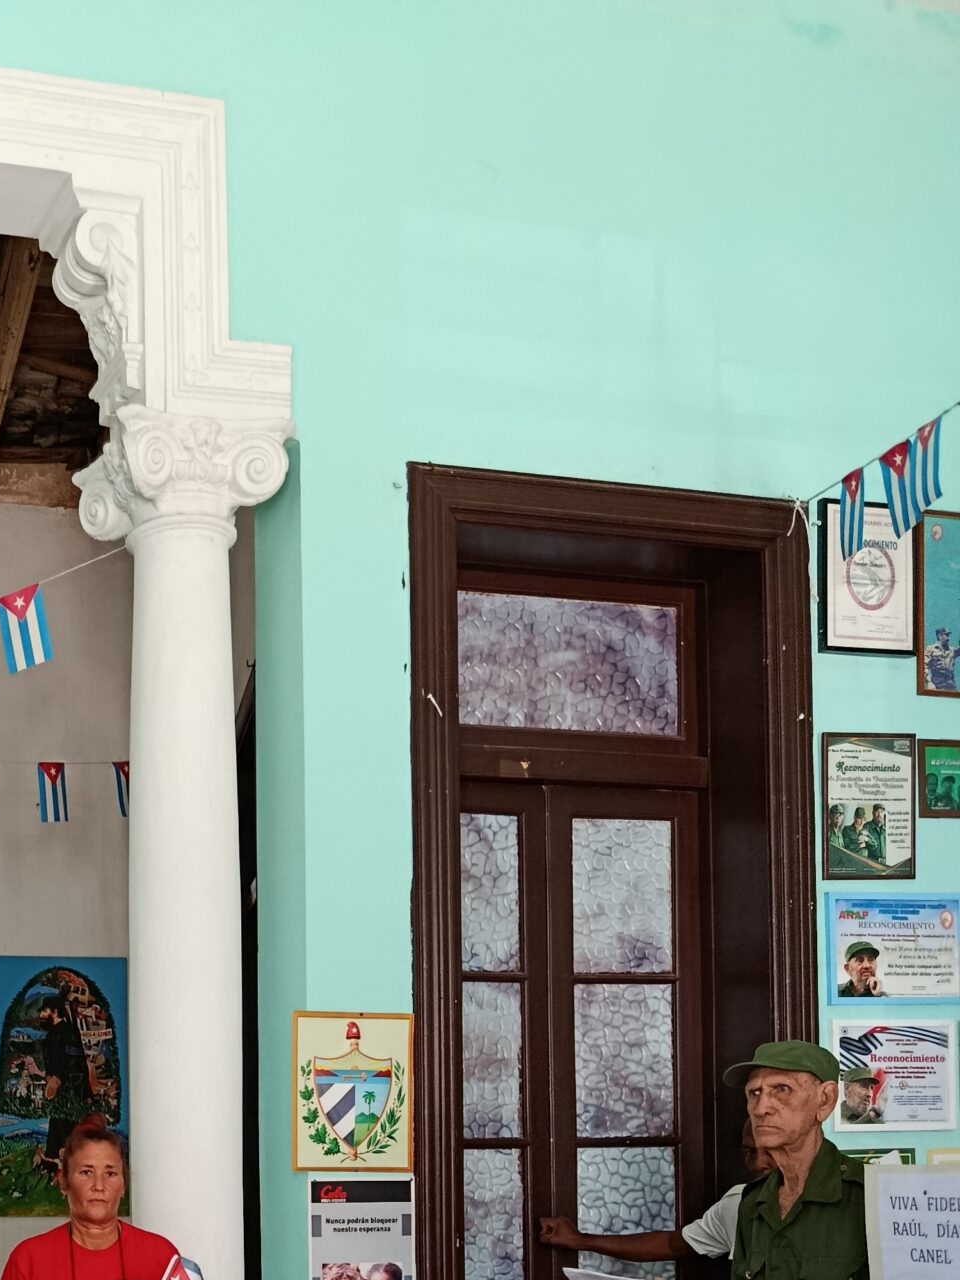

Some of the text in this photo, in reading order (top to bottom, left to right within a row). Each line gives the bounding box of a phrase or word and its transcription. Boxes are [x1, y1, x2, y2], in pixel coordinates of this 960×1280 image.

[835, 761, 901, 776] Reconocimiento
[858, 921, 936, 930] RECONOCIMIENTO
[870, 1054, 946, 1063] Reconocimiento
[889, 1196, 919, 1211] VIVA
[325, 1217, 398, 1226] Nunca podrán bloquear
[358, 1226, 391, 1234] esperanza
[892, 1218, 960, 1239] RAÚL, DÍA
[910, 1248, 952, 1265] CANEL
